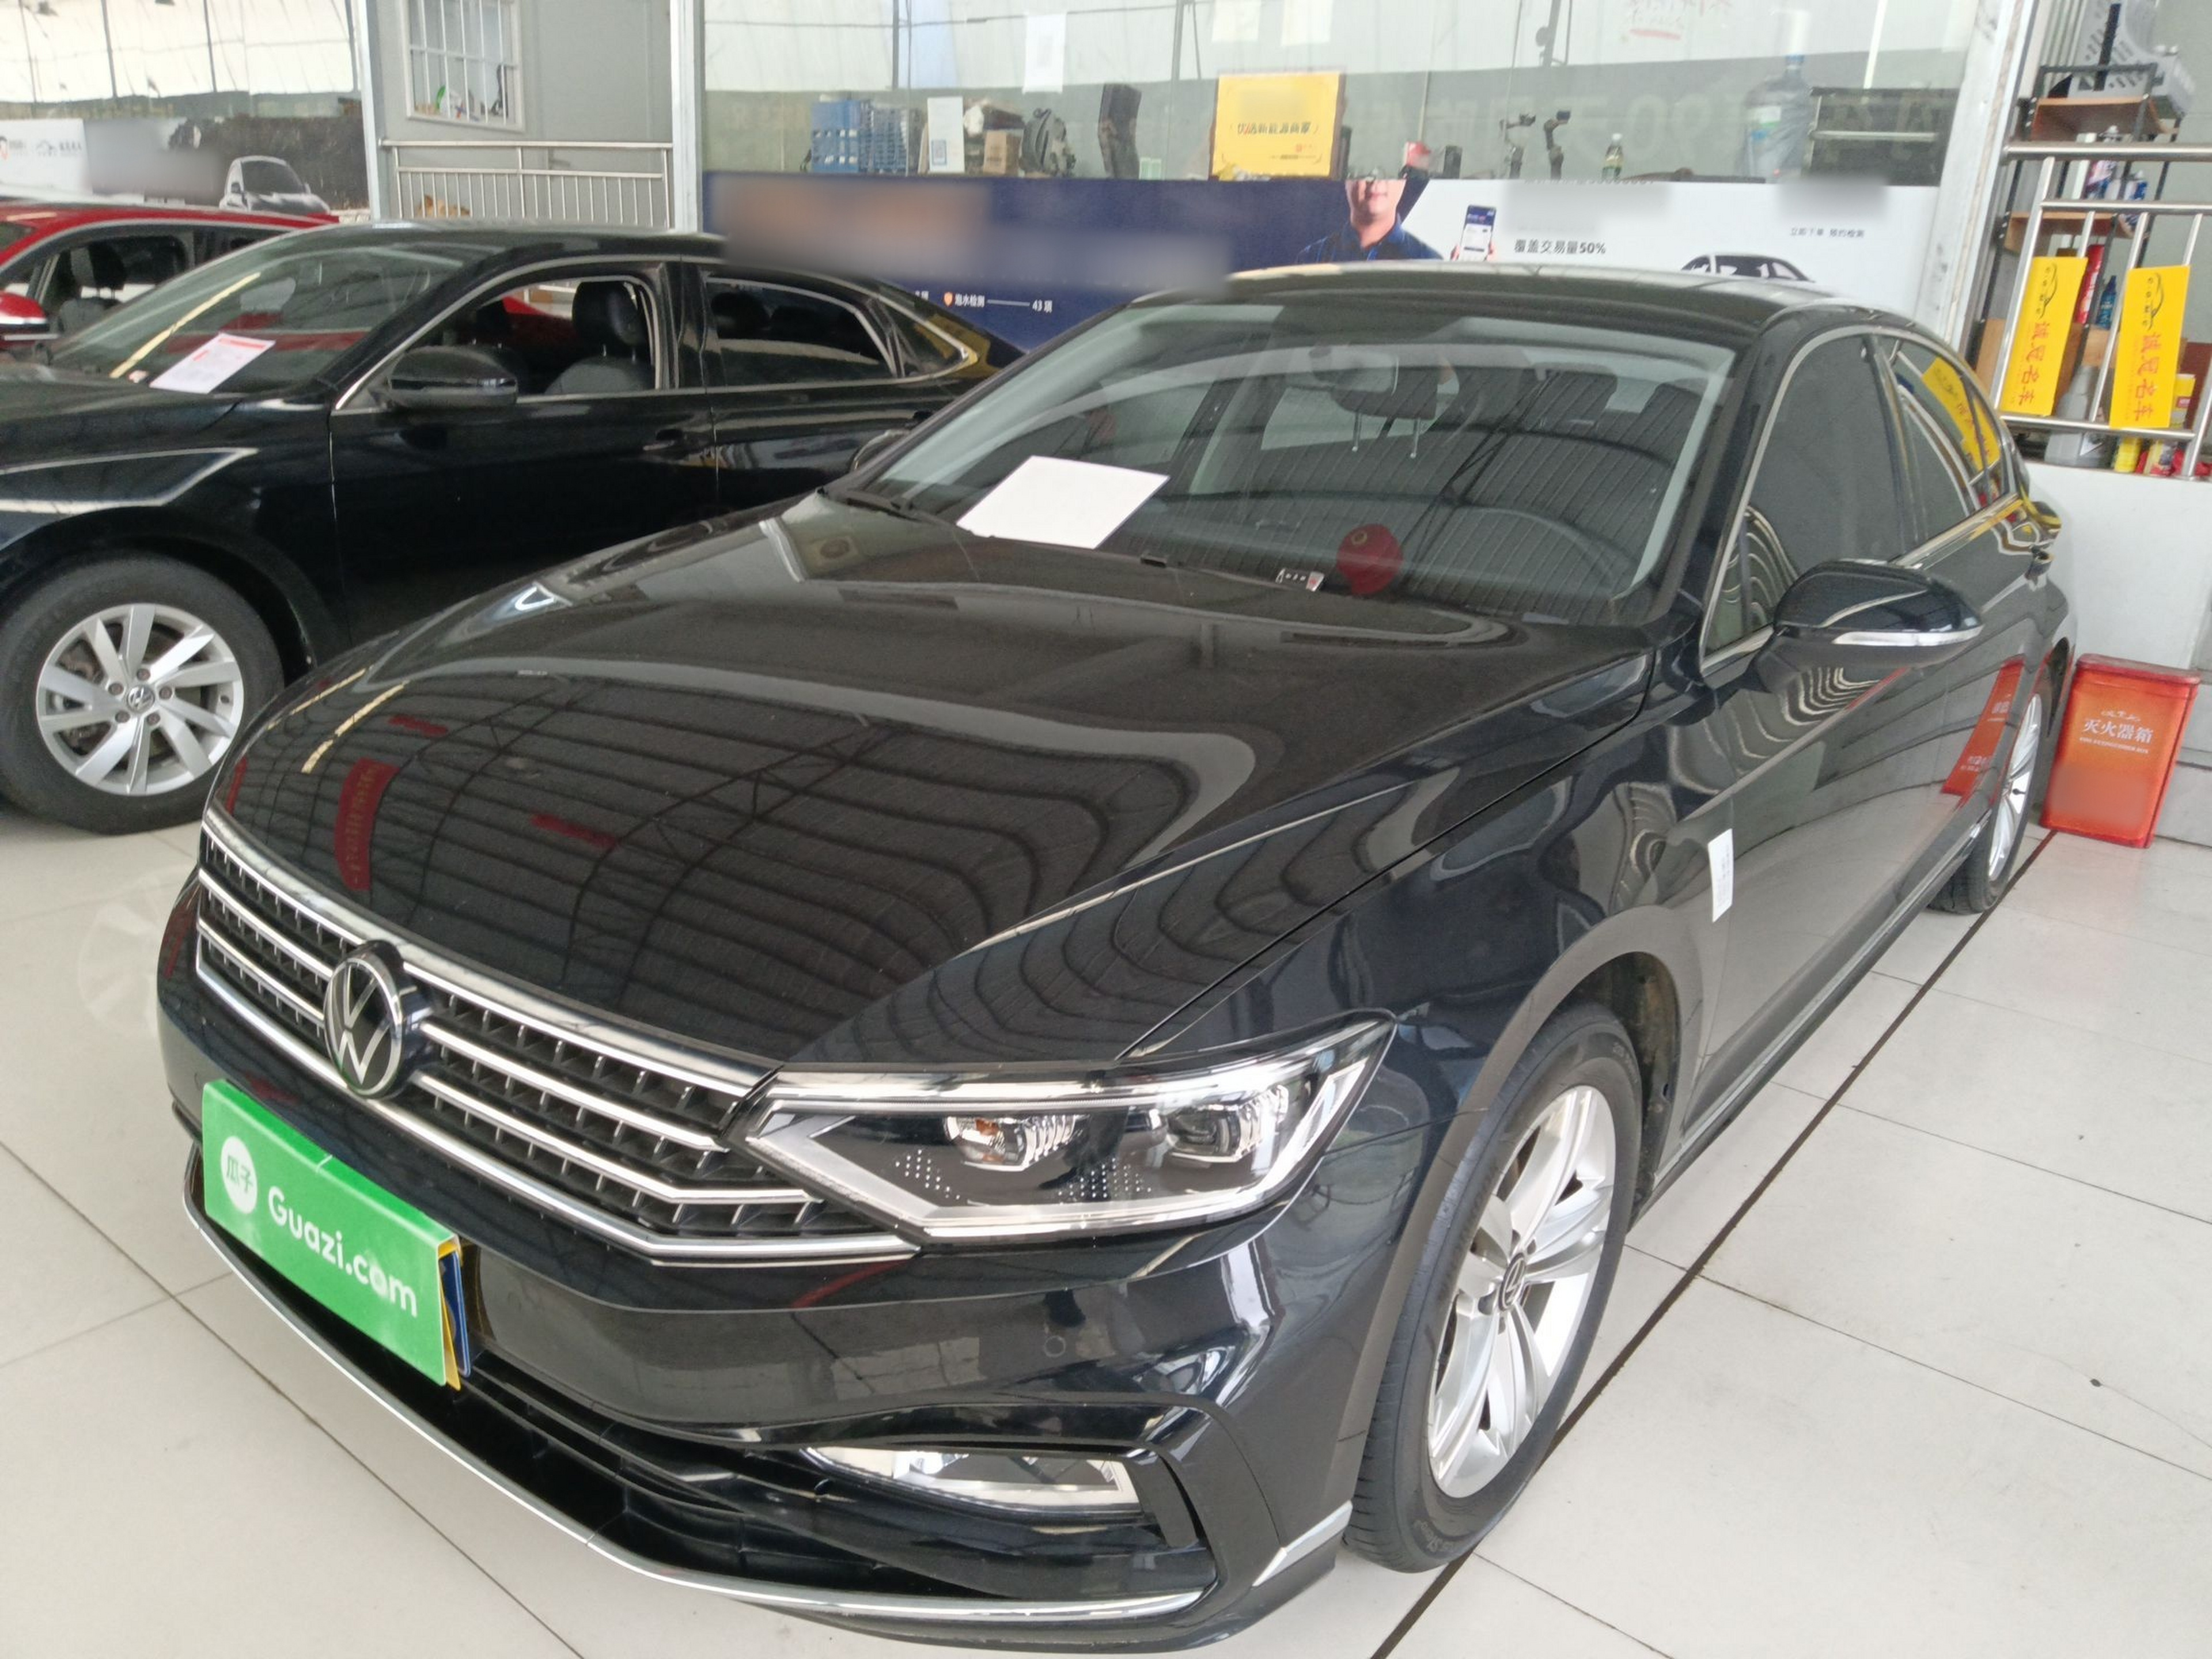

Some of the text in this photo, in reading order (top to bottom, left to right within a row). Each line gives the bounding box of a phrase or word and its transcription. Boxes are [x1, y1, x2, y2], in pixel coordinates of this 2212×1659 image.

[1514, 238, 1606, 255] 覆盖交易量50%
[2082, 718, 2154, 744] 灭火器箱
[268, 1185, 418, 1318] Guazi.com
